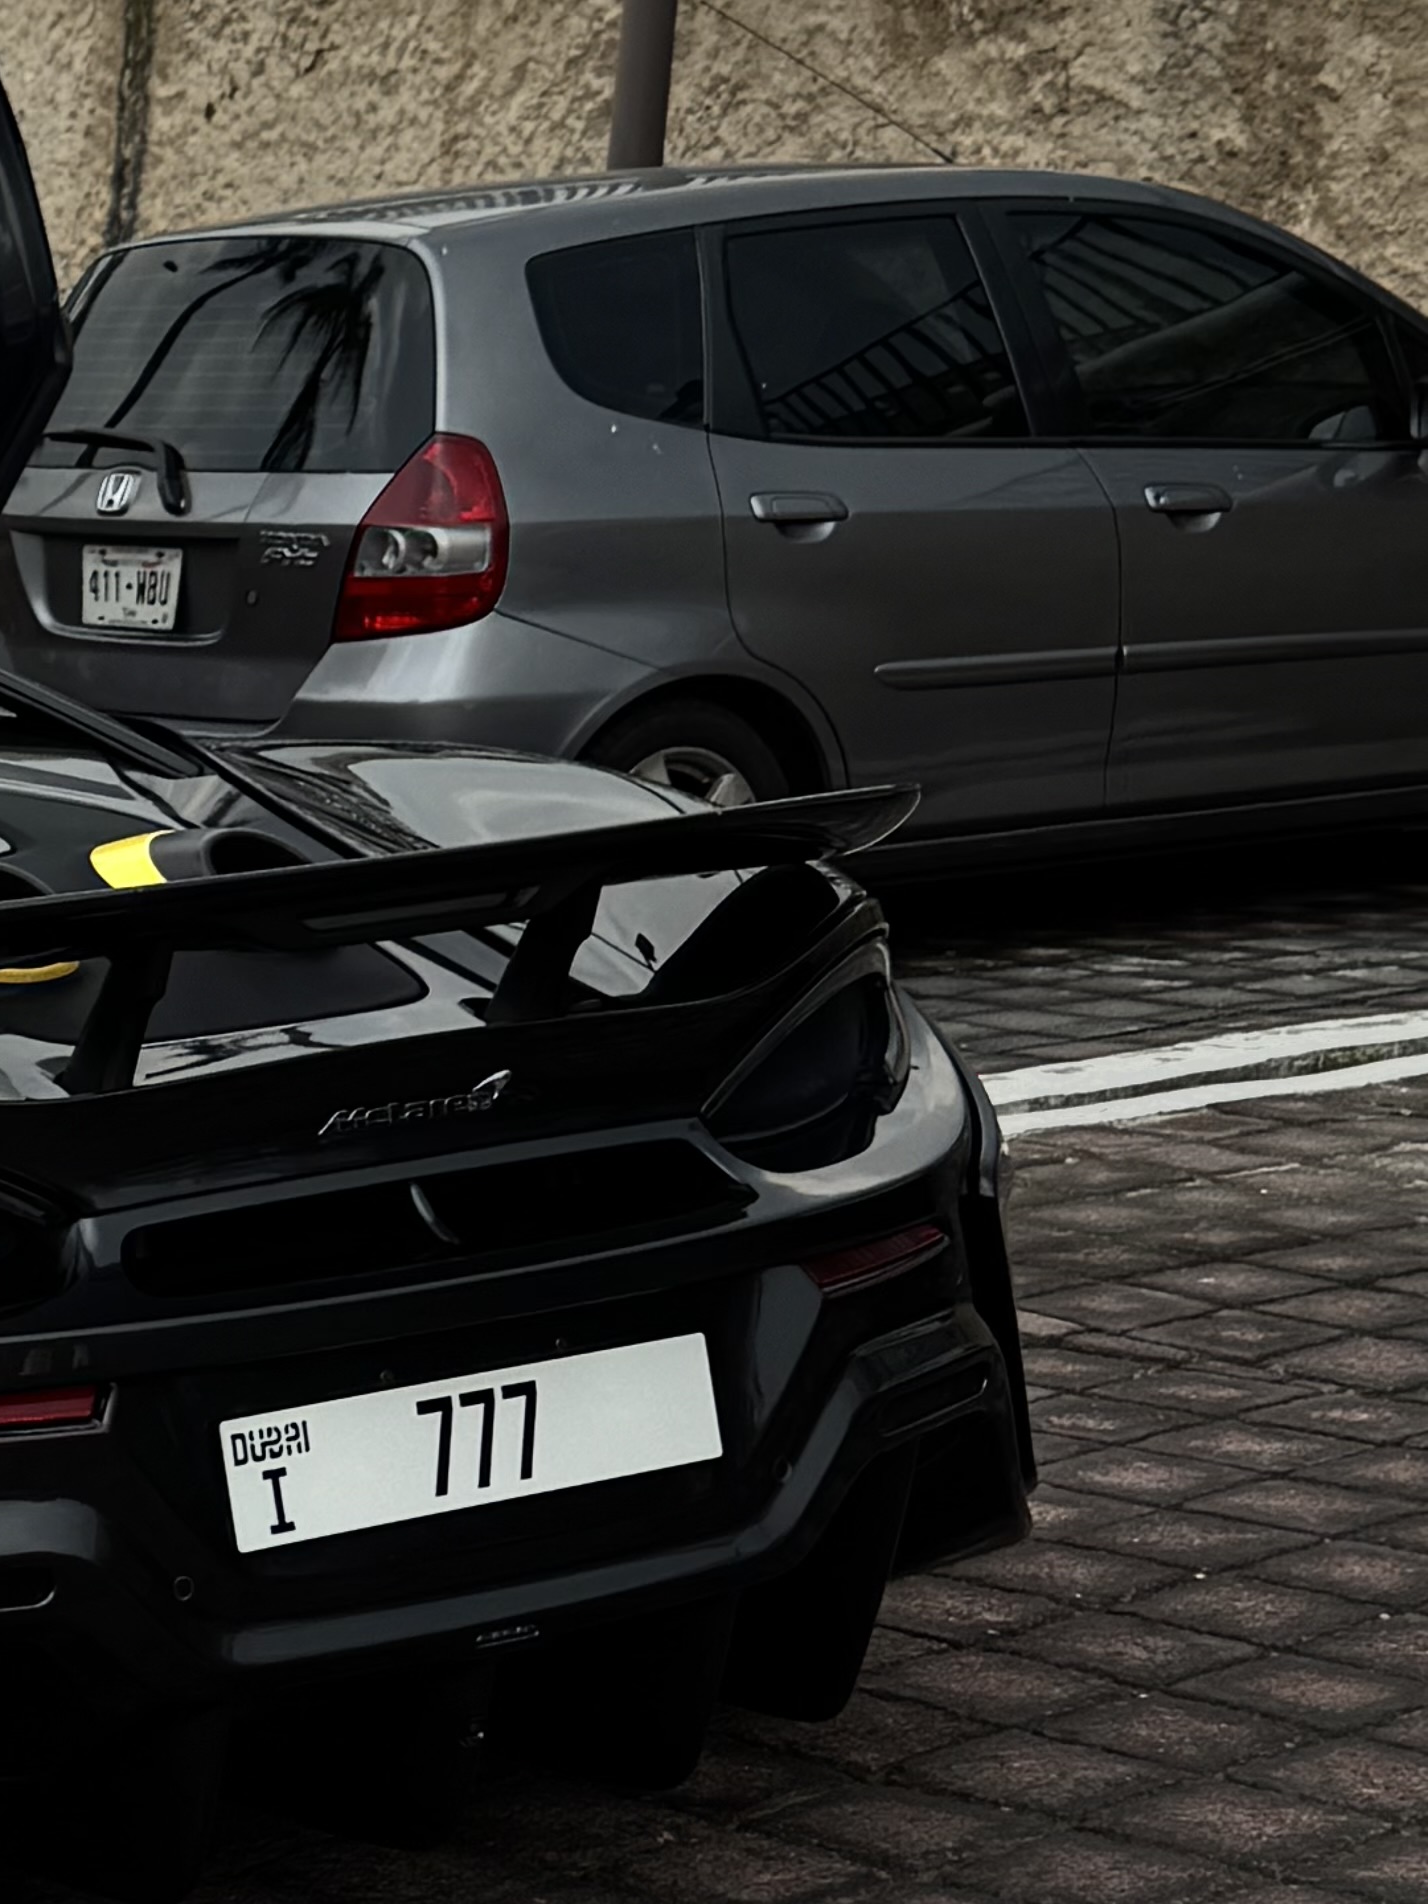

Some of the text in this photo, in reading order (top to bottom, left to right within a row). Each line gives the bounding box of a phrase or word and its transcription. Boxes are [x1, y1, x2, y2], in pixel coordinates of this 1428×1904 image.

[230, 1419, 311, 1467] DUBAI
[415, 1379, 538, 1498] 777
[261, 1466, 297, 1536] I
